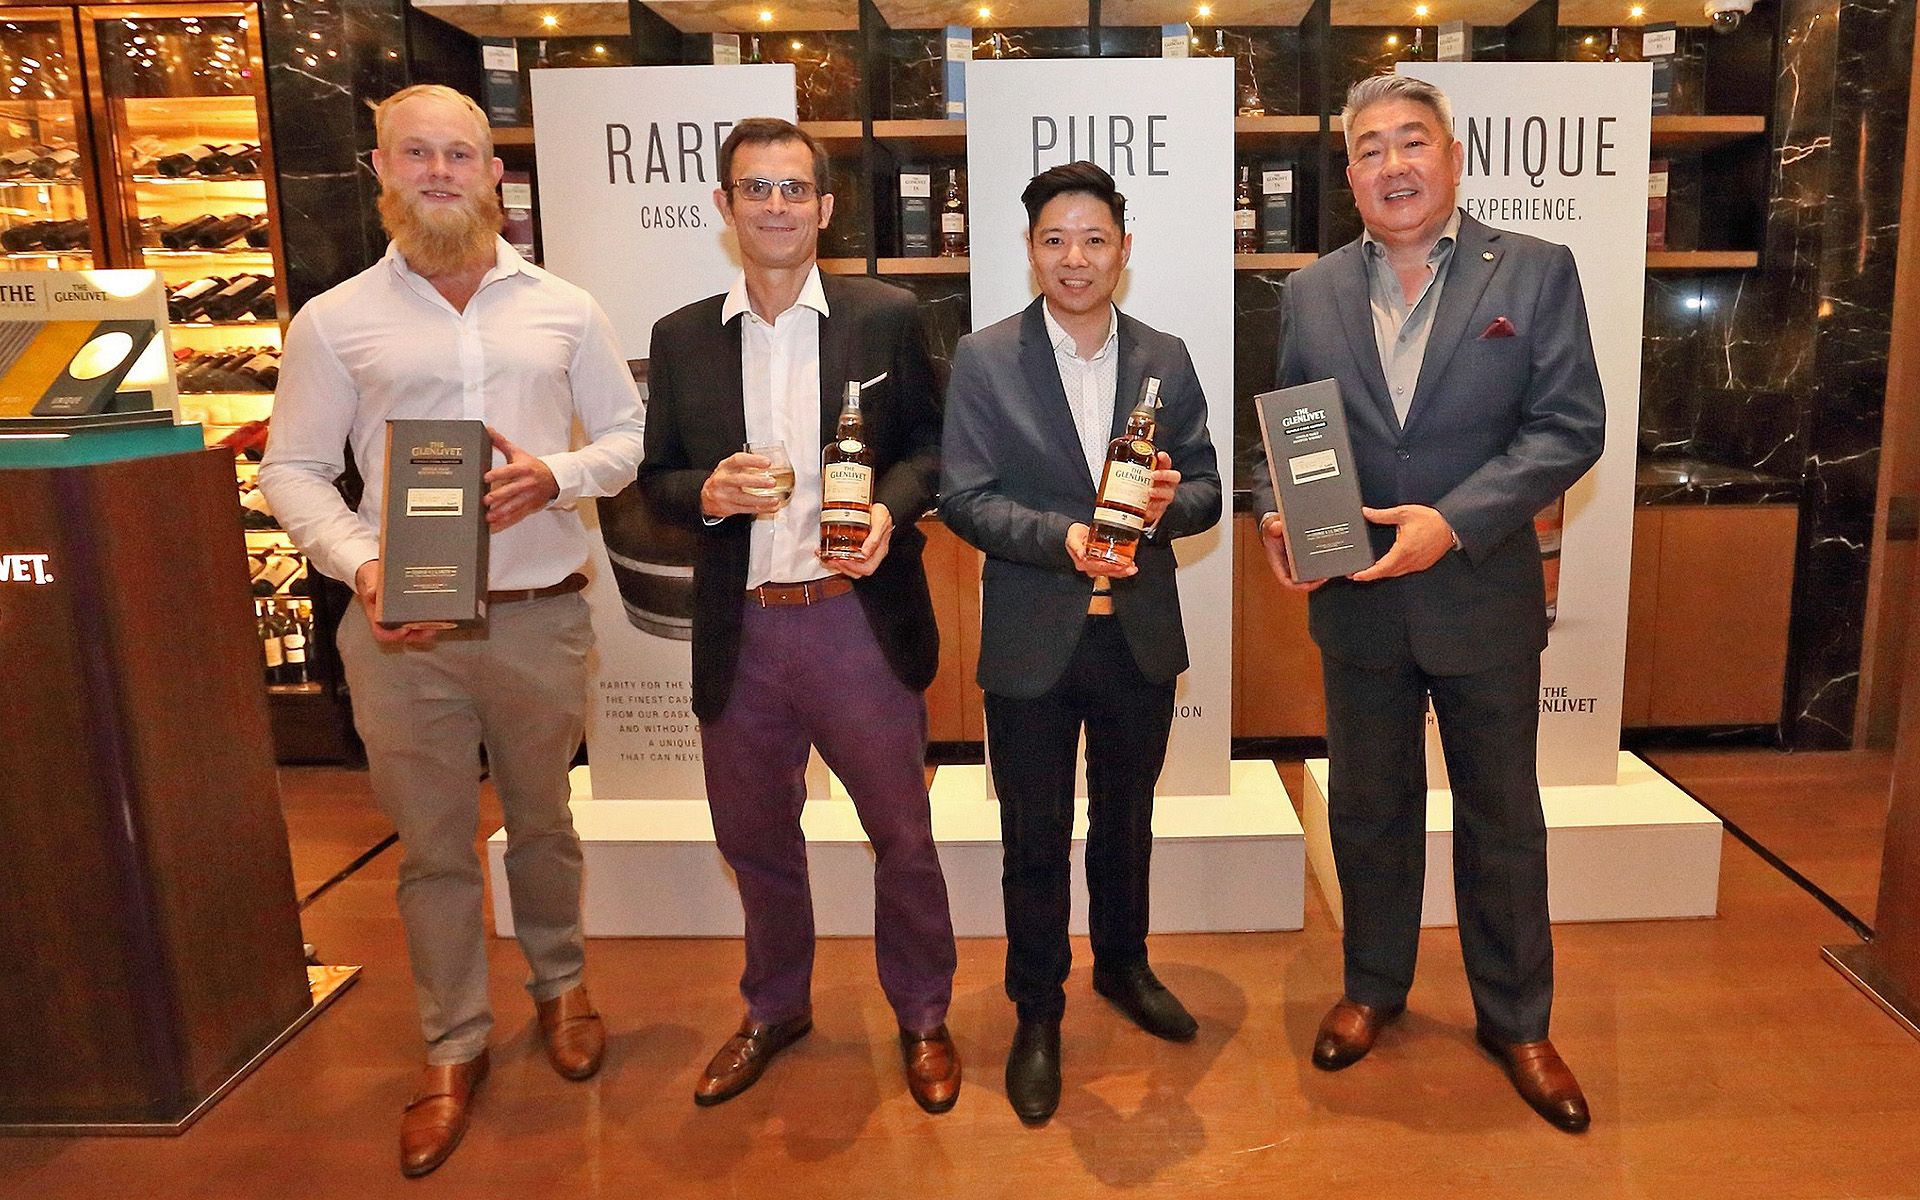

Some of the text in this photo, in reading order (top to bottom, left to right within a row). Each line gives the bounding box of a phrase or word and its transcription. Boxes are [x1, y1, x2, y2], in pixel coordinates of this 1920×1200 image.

[1033, 115, 1169, 176] PURE
[1452, 116, 1617, 188] NIQUE
[1466, 198, 1582, 221] EXPERIENCE.
[641, 205, 707, 228] CASKS.
[831, 472, 866, 480] GLENLIVET
[600, 681, 635, 689] RARITY
[641, 681, 660, 689] FOR
[666, 681, 684, 689] THE
[1543, 686, 1567, 697] THE
[606, 696, 624, 704] THE
[629, 696, 663, 704] FINEST
[1538, 698, 1597, 713] NLIVET
[606, 710, 690, 718] FROM OUR CASK
[620, 725, 639, 733] AND
[645, 725, 689, 733] WITHOUT
[660, 739, 697, 748] UNIQUE
[621, 753, 700, 761] THAT CAN NEVE
